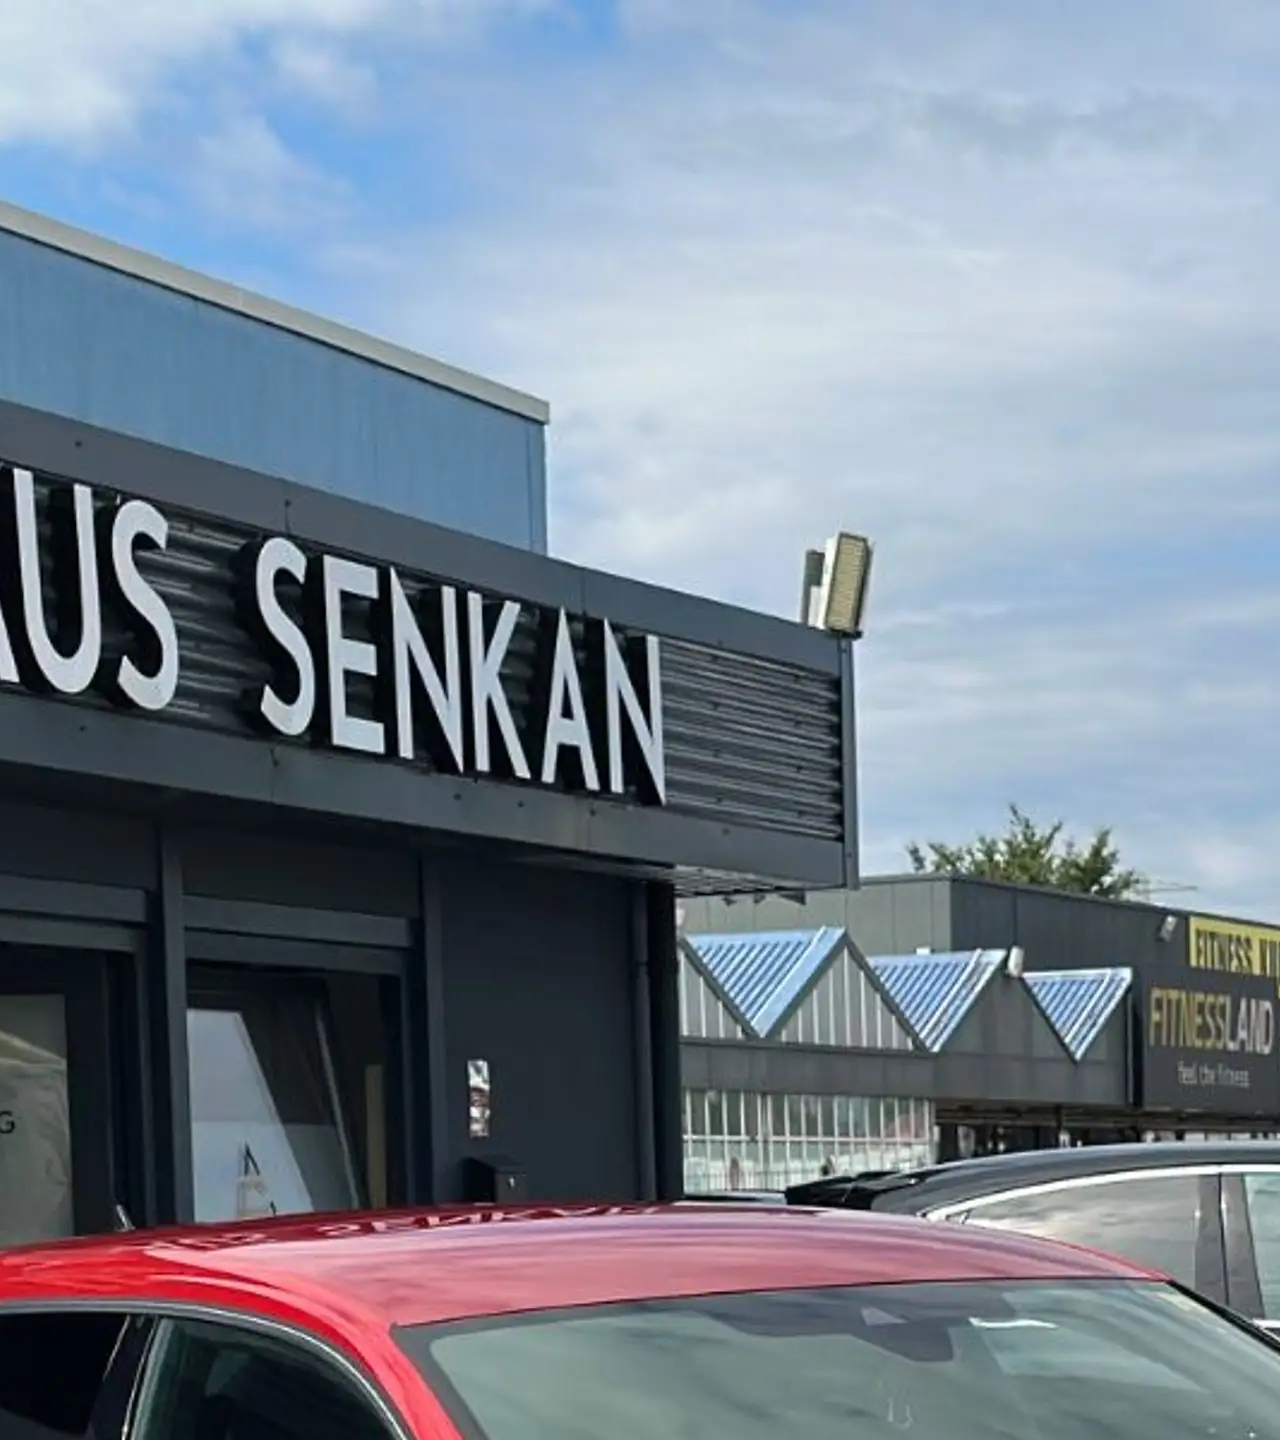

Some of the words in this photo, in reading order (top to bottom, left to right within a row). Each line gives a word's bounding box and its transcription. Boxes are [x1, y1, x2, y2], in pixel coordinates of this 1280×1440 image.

[255, 536, 667, 806] SENKAN
[1194, 928, 1252, 973] FITNESS
[1149, 987, 1274, 1056] FITNESSLAND
